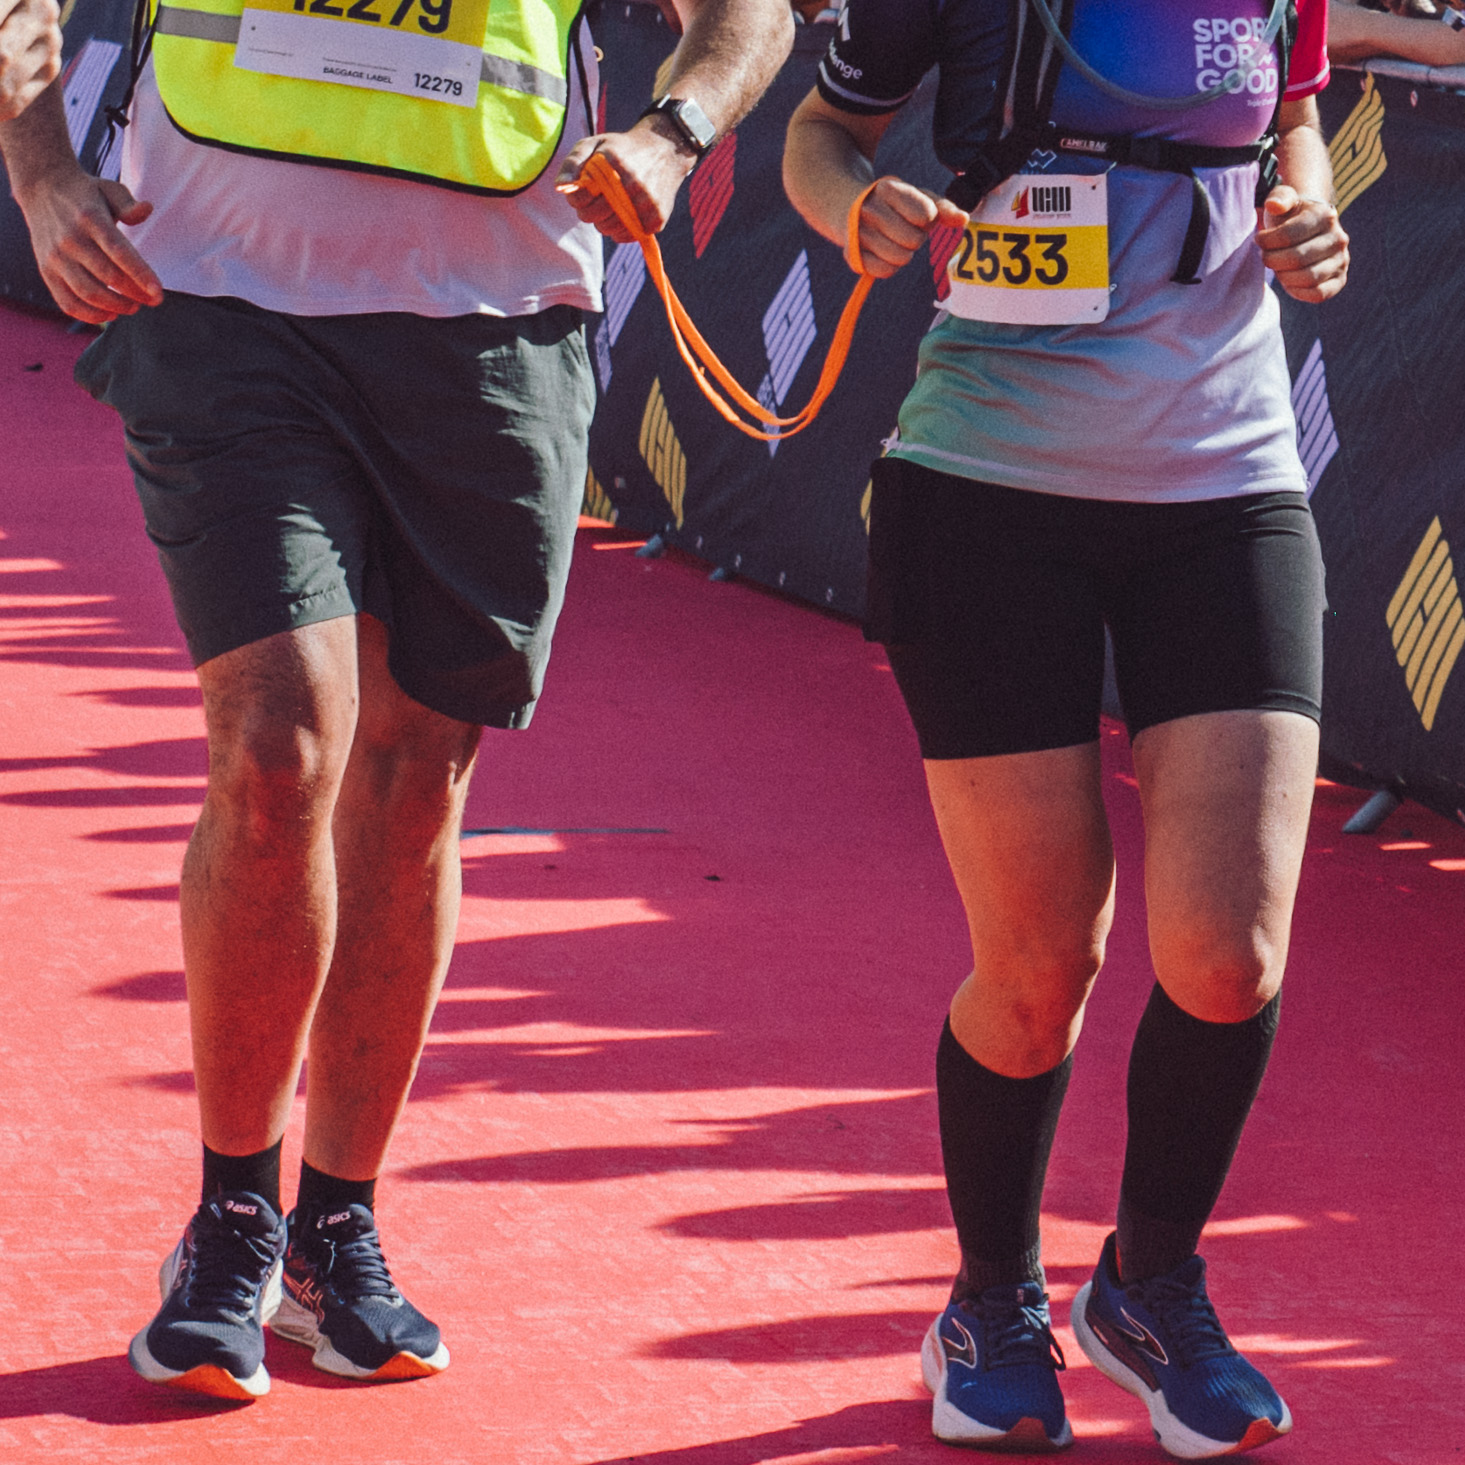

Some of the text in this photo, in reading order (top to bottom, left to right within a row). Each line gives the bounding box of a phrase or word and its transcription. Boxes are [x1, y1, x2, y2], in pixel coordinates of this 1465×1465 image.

[1193, 17, 1270, 43] SPOR
[1195, 43, 1257, 69] FOR
[323, 66, 463, 96] BAGGAGE LABEL 12279
[1196, 68, 1278, 94] GOOD
